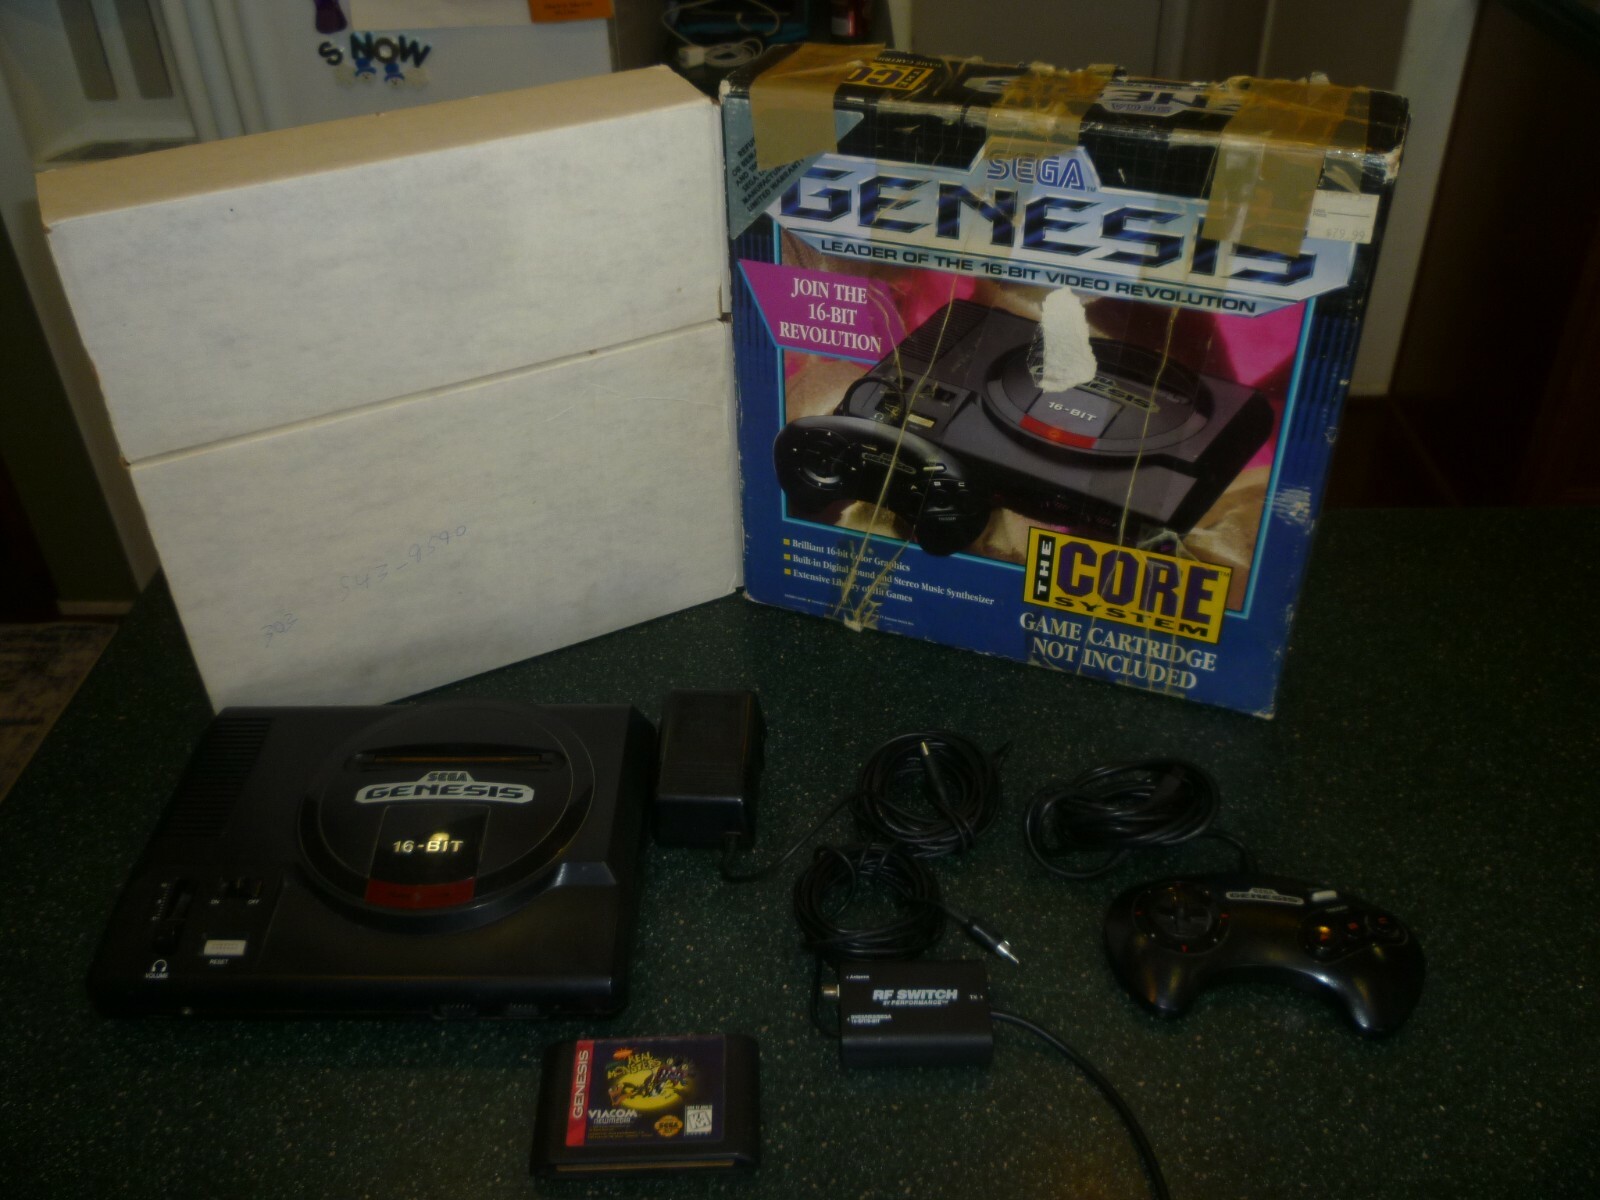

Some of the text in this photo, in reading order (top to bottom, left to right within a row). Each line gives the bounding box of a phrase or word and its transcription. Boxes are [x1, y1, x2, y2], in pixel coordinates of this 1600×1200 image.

[986, 154, 1086, 192] SEGA
[747, 188, 771, 212] LIMITED
[790, 277, 868, 305] JOIN THE
[821, 239, 1257, 313] LEADER OF THE 16-BIT VIDEO REVOLUTION
[807, 302, 858, 326] 16-BIT
[779, 320, 882, 354] REVOLUTION
[1048, 401, 1097, 421] 16-BIT
[792, 539, 825, 556] Brilliant
[826, 545, 849, 560] 16-bit
[792, 553, 822, 568] Built-in
[823, 560, 849, 574] Digital
[893, 576, 920, 590] Stereo
[921, 582, 945, 595] Music
[946, 587, 995, 606] Synthesizer
[793, 568, 831, 585] Extensive
[885, 588, 913, 603] Games
[1036, 539, 1053, 595] THE
[1056, 540, 1219, 626] CORE
[1054, 596, 1209, 638] SYSTEM
[1018, 611, 1218, 672] GAME CARTRIDGE
[1031, 636, 1198, 690] NOT INCLUDED
[364, 784, 524, 800] GENESIS
[427, 772, 468, 782] SEGA
[392, 839, 464, 854] 16-BIT
[872, 989, 959, 1001] RF SWITCH
[572, 1050, 589, 1119] GENESIS
[587, 1109, 638, 1119] VIACOM
